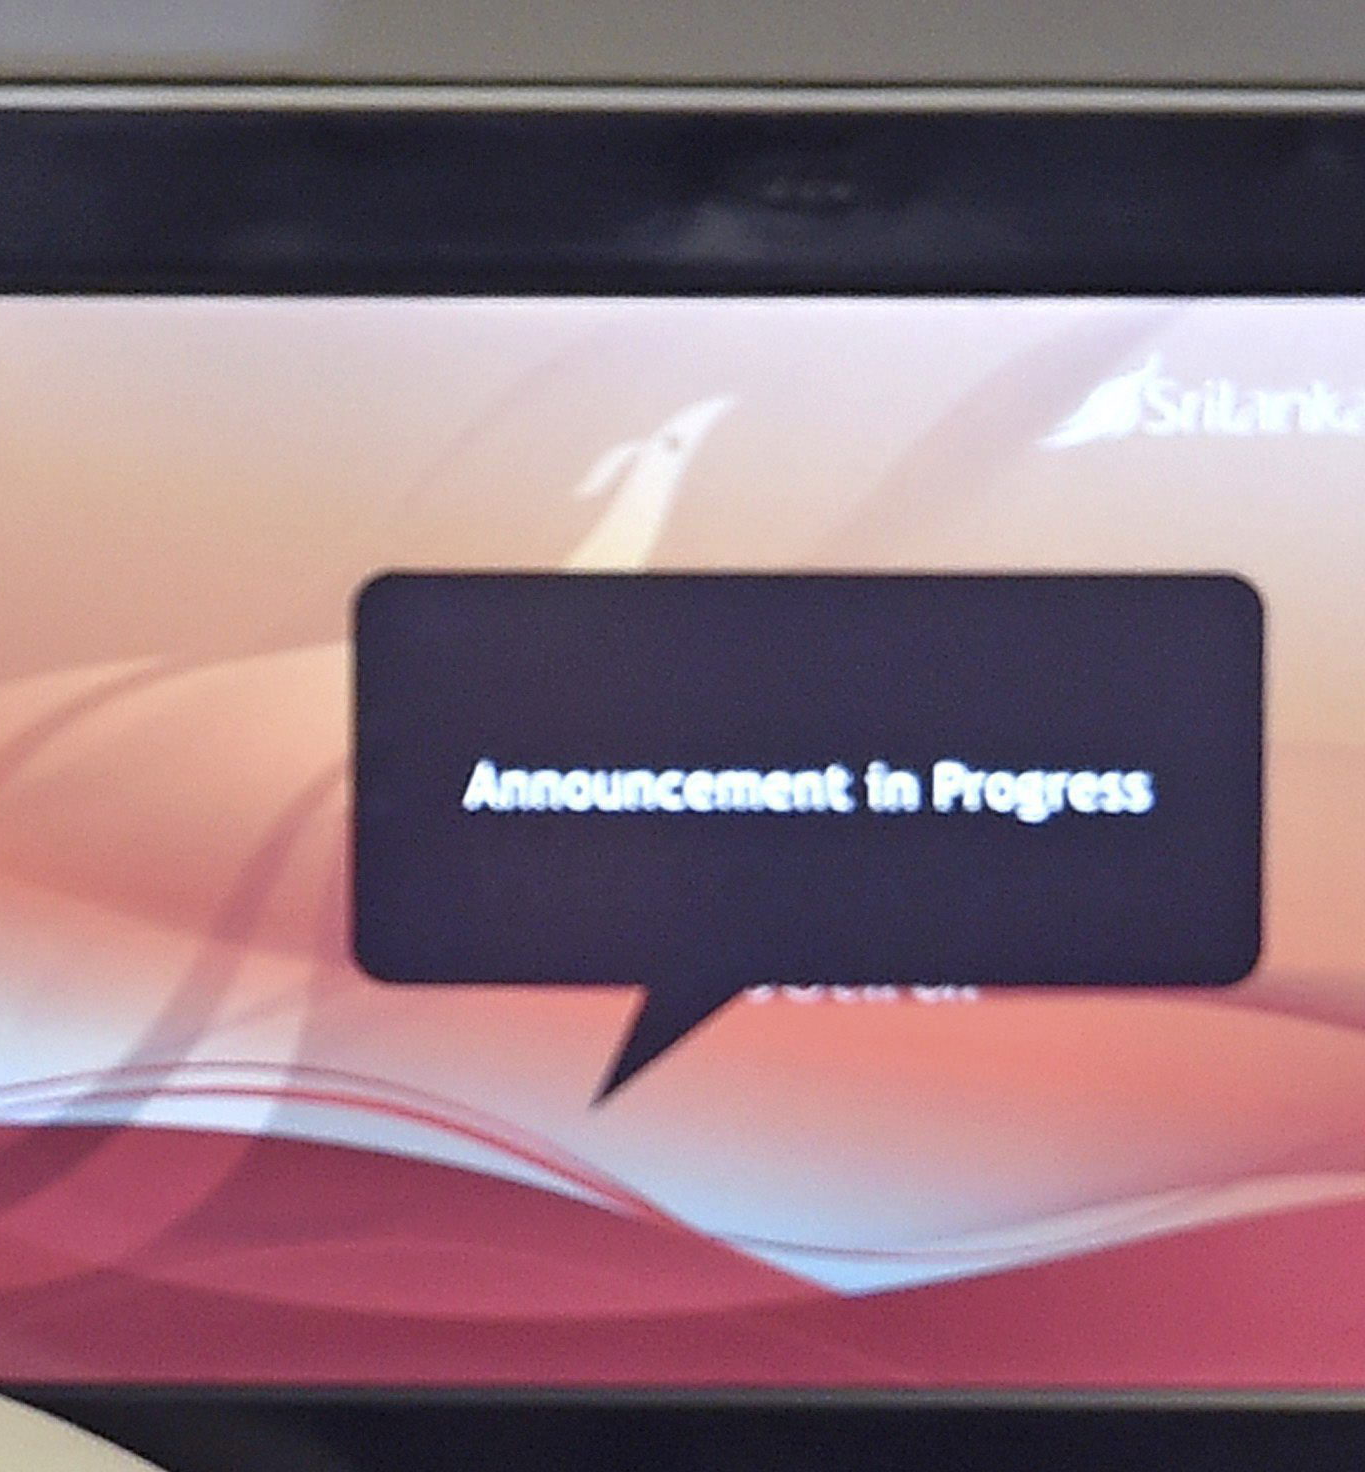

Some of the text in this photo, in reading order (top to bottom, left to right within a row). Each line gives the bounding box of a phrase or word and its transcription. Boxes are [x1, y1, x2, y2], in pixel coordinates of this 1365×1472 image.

[463, 758, 1155, 824] Announcement in Progress
